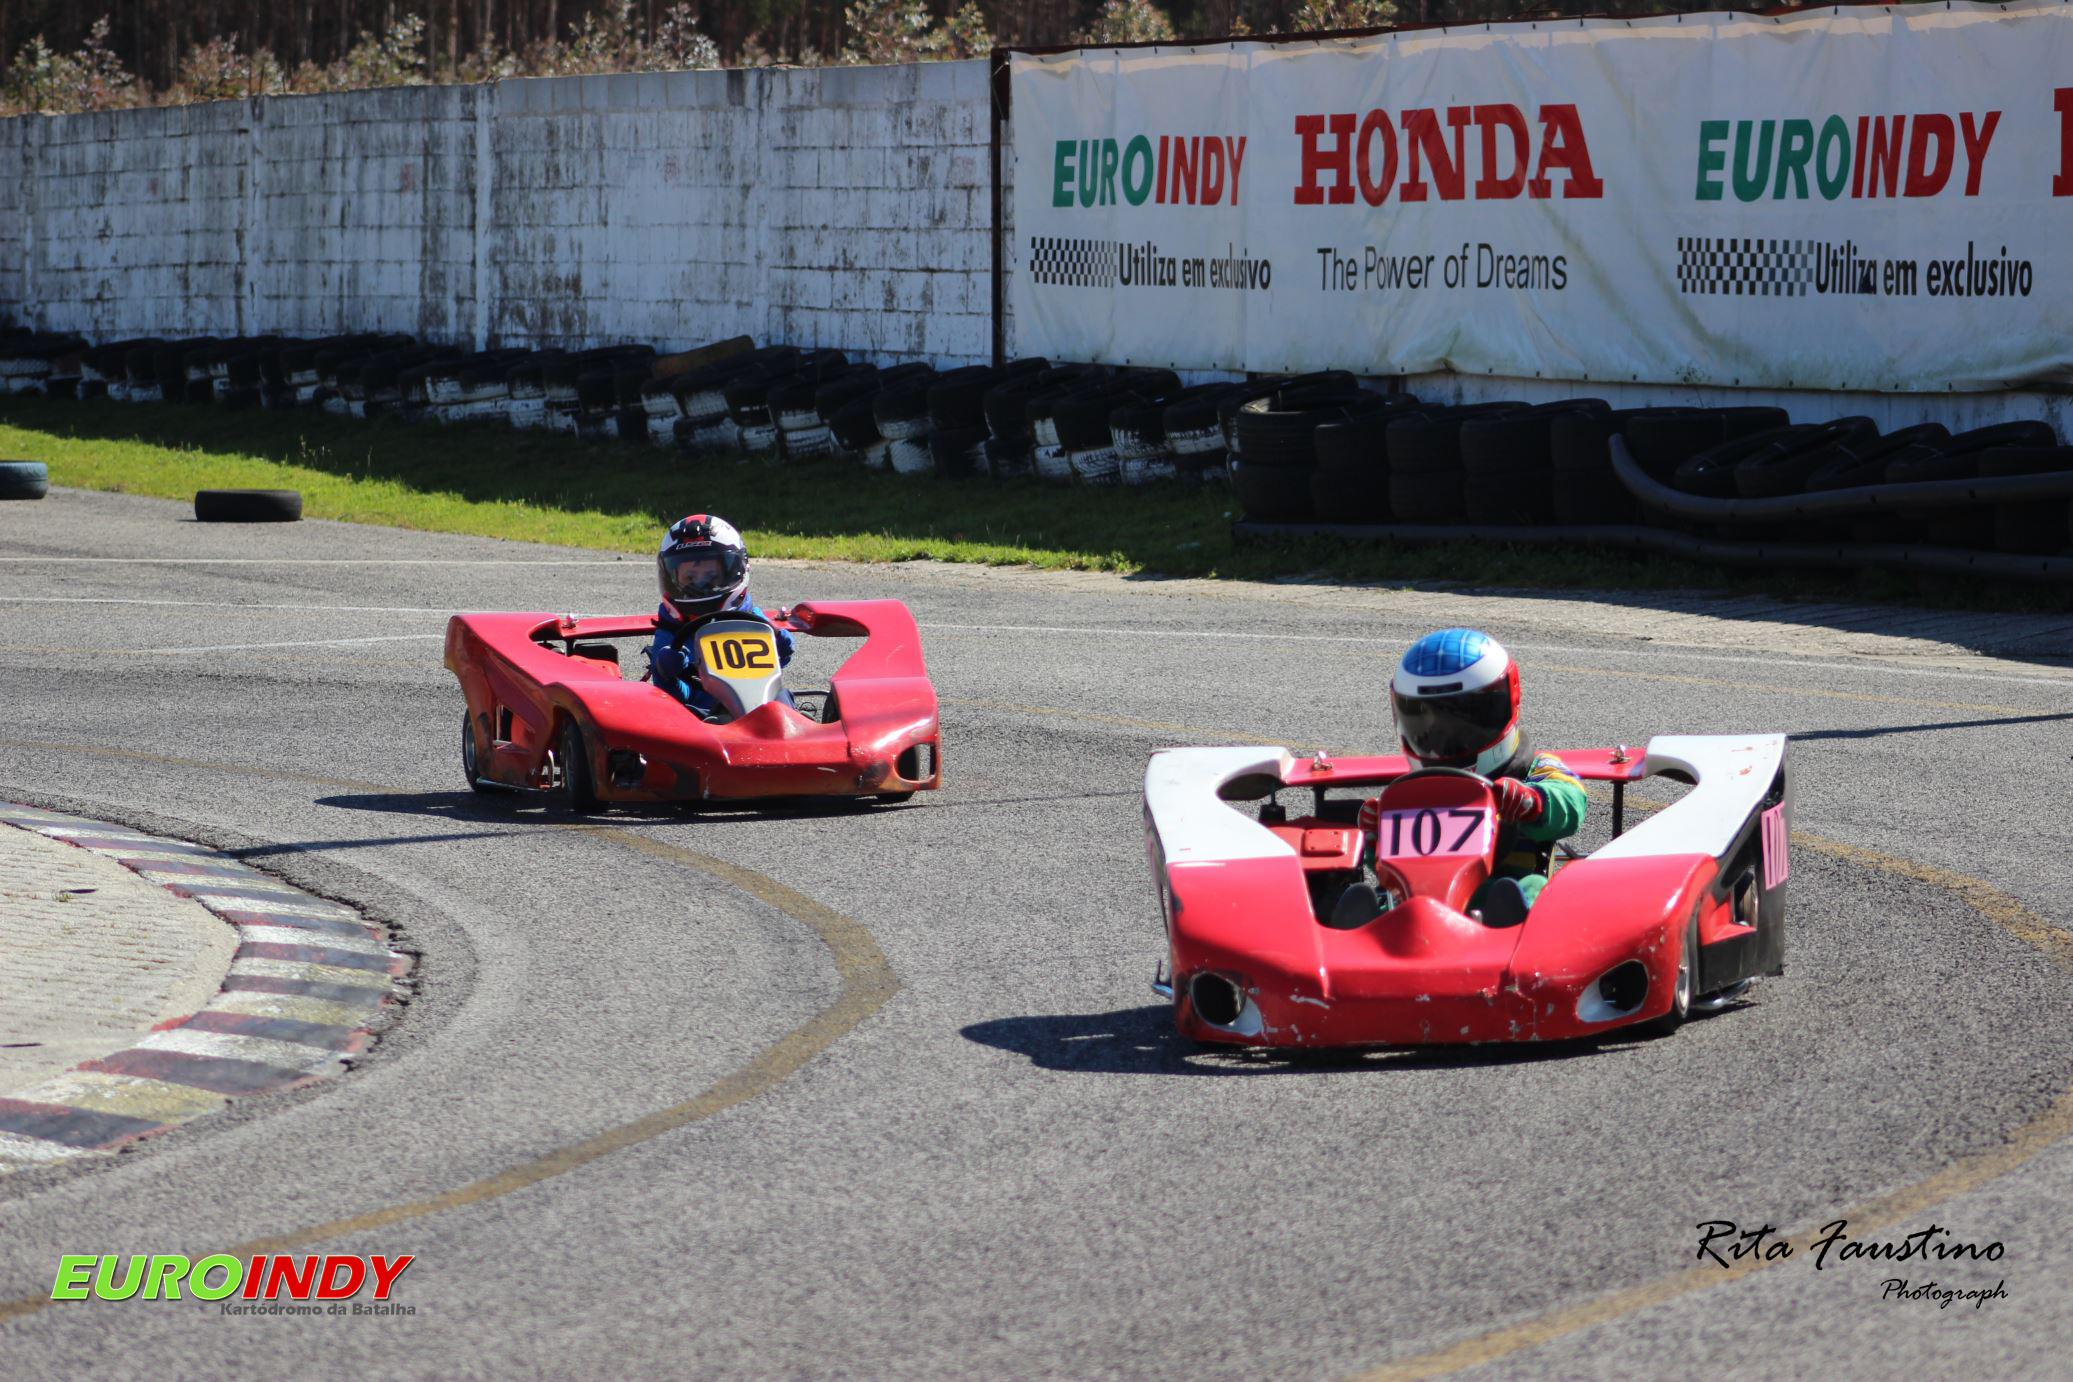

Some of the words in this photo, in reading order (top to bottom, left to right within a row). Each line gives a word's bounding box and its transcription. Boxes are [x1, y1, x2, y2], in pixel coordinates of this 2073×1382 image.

[1052, 134, 1247, 208] EUROINDY
[1294, 103, 1604, 207] HONDA
[1695, 111, 2002, 202] EUROINDY
[1119, 240, 1177, 286] Utiliza
[1182, 258, 1205, 288] em
[1210, 242, 1271, 290] exclusivo
[1317, 247, 1358, 291] The
[1364, 246, 1434, 290] Power
[1444, 243, 1469, 288] of
[1477, 243, 1568, 290] Dreams
[1815, 239, 1877, 295] Utiliza
[1883, 259, 1917, 296] em
[1926, 240, 2033, 297] exclusivo
[710, 638, 775, 670] 102
[1390, 808, 1486, 856] 107
